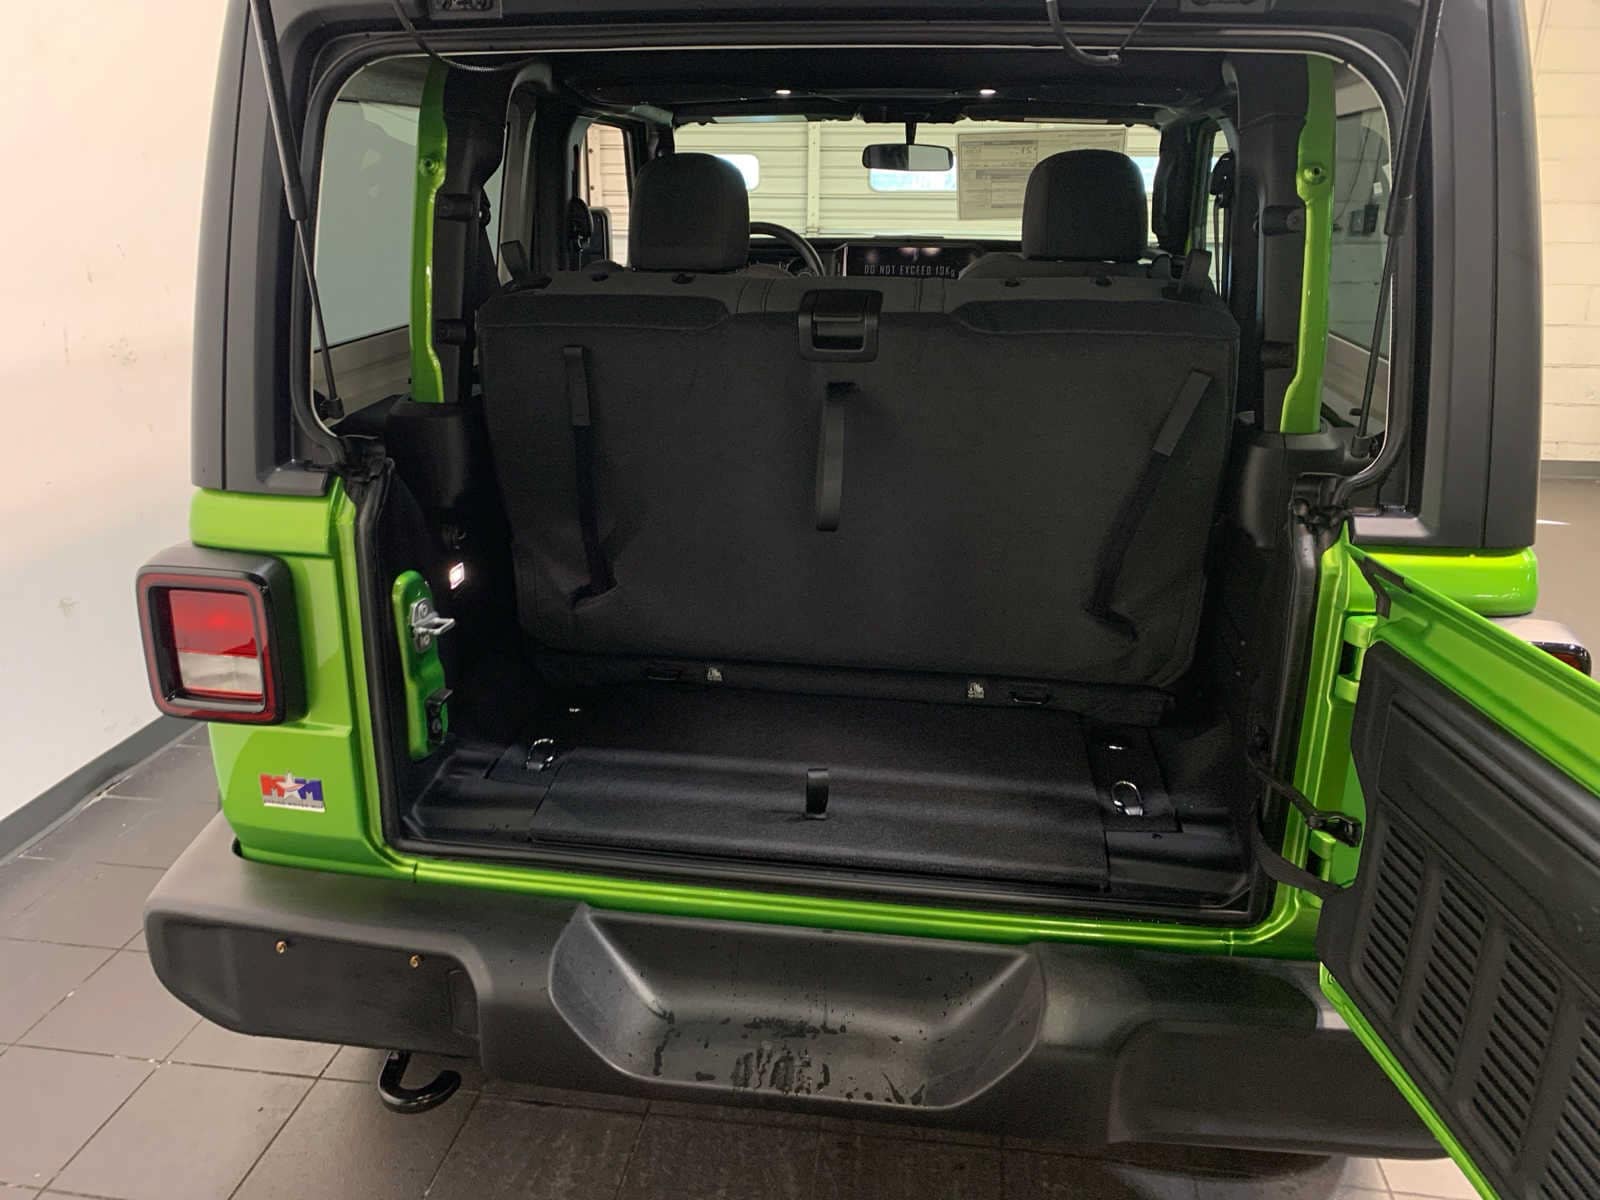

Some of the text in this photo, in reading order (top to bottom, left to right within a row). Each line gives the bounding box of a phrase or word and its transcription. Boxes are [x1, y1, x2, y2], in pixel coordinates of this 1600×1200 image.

[864, 264, 875, 274] DO
[879, 264, 896, 275] NOT
[899, 264, 932, 276] EXCEED
